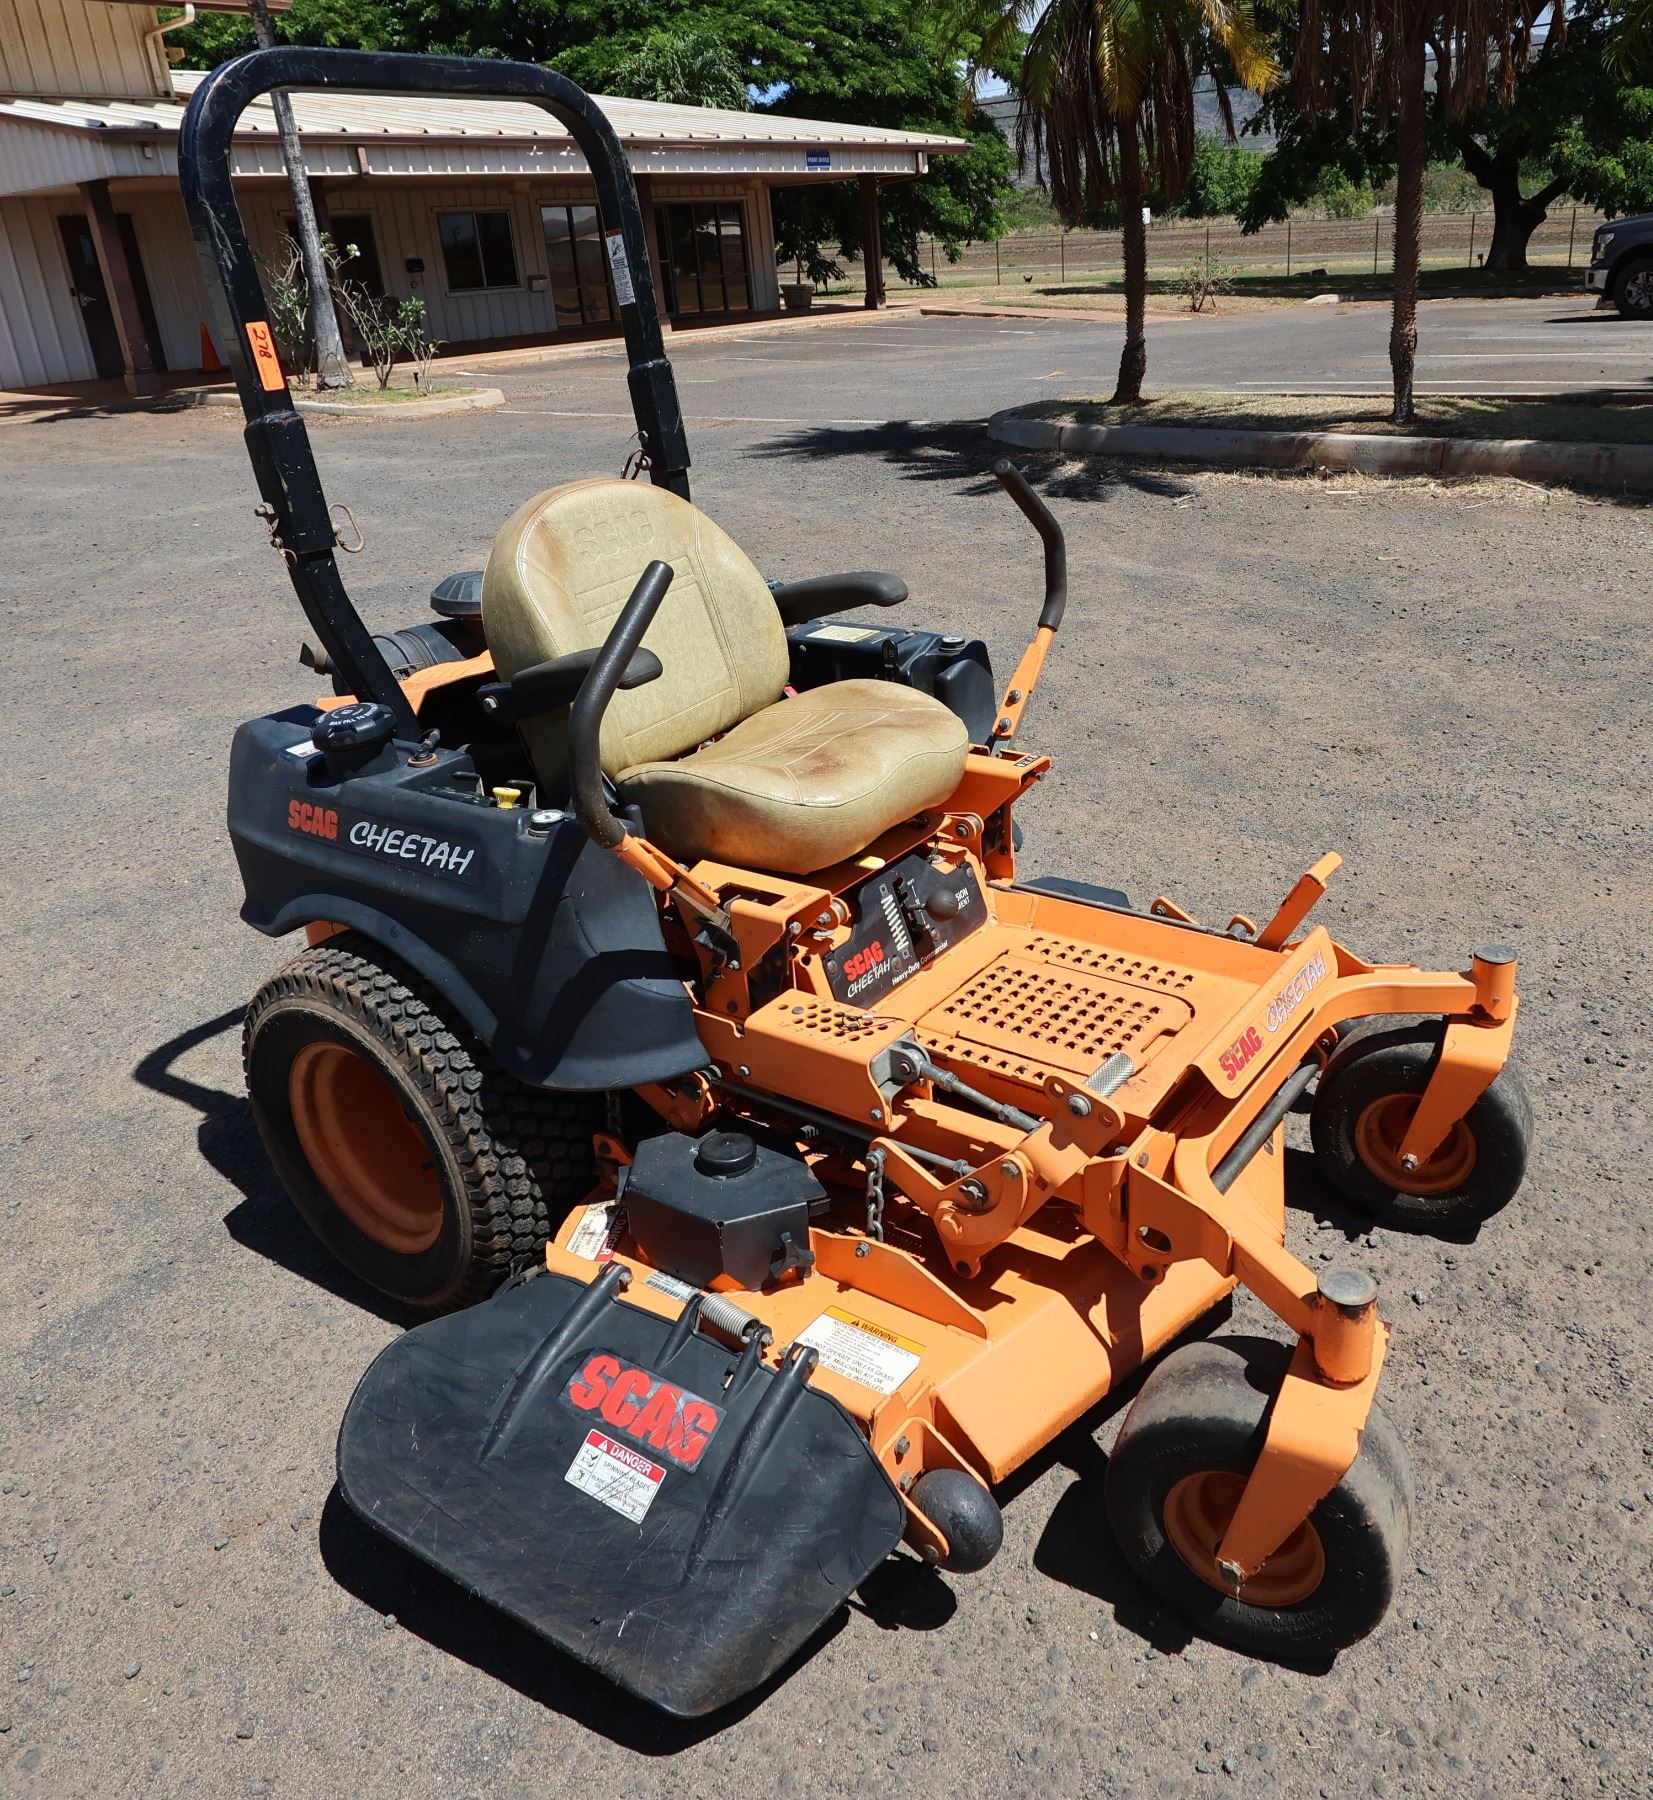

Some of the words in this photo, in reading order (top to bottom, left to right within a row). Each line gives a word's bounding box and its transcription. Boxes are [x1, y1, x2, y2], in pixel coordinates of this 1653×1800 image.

[252, 327, 272, 359] 278
[575, 511, 654, 563] SCAG
[288, 799, 340, 842] SCAG
[349, 821, 475, 875] CHEETAH
[842, 940, 885, 982] SCAG
[847, 957, 892, 998] CHEETAH
[891, 961, 920, 986] Heavy-Duty
[920, 941, 948, 964] Commercial
[1219, 1026, 1264, 1081] SCAG
[1265, 950, 1327, 1033] CHEETAH
[861, 1323, 898, 1344] WARNING
[814, 1340, 826, 1350] NOT
[826, 1347, 851, 1362] OPERATE
[852, 1358, 874, 1372] UNLESS
[833, 1357, 864, 1375] MULCHING
[864, 1372, 873, 1380] KIT
[826, 1362, 846, 1376] CHUTE
[853, 1375, 884, 1392] INSTALLED
[569, 1354, 718, 1467] SCAG
[609, 1446, 652, 1476] DANGER
